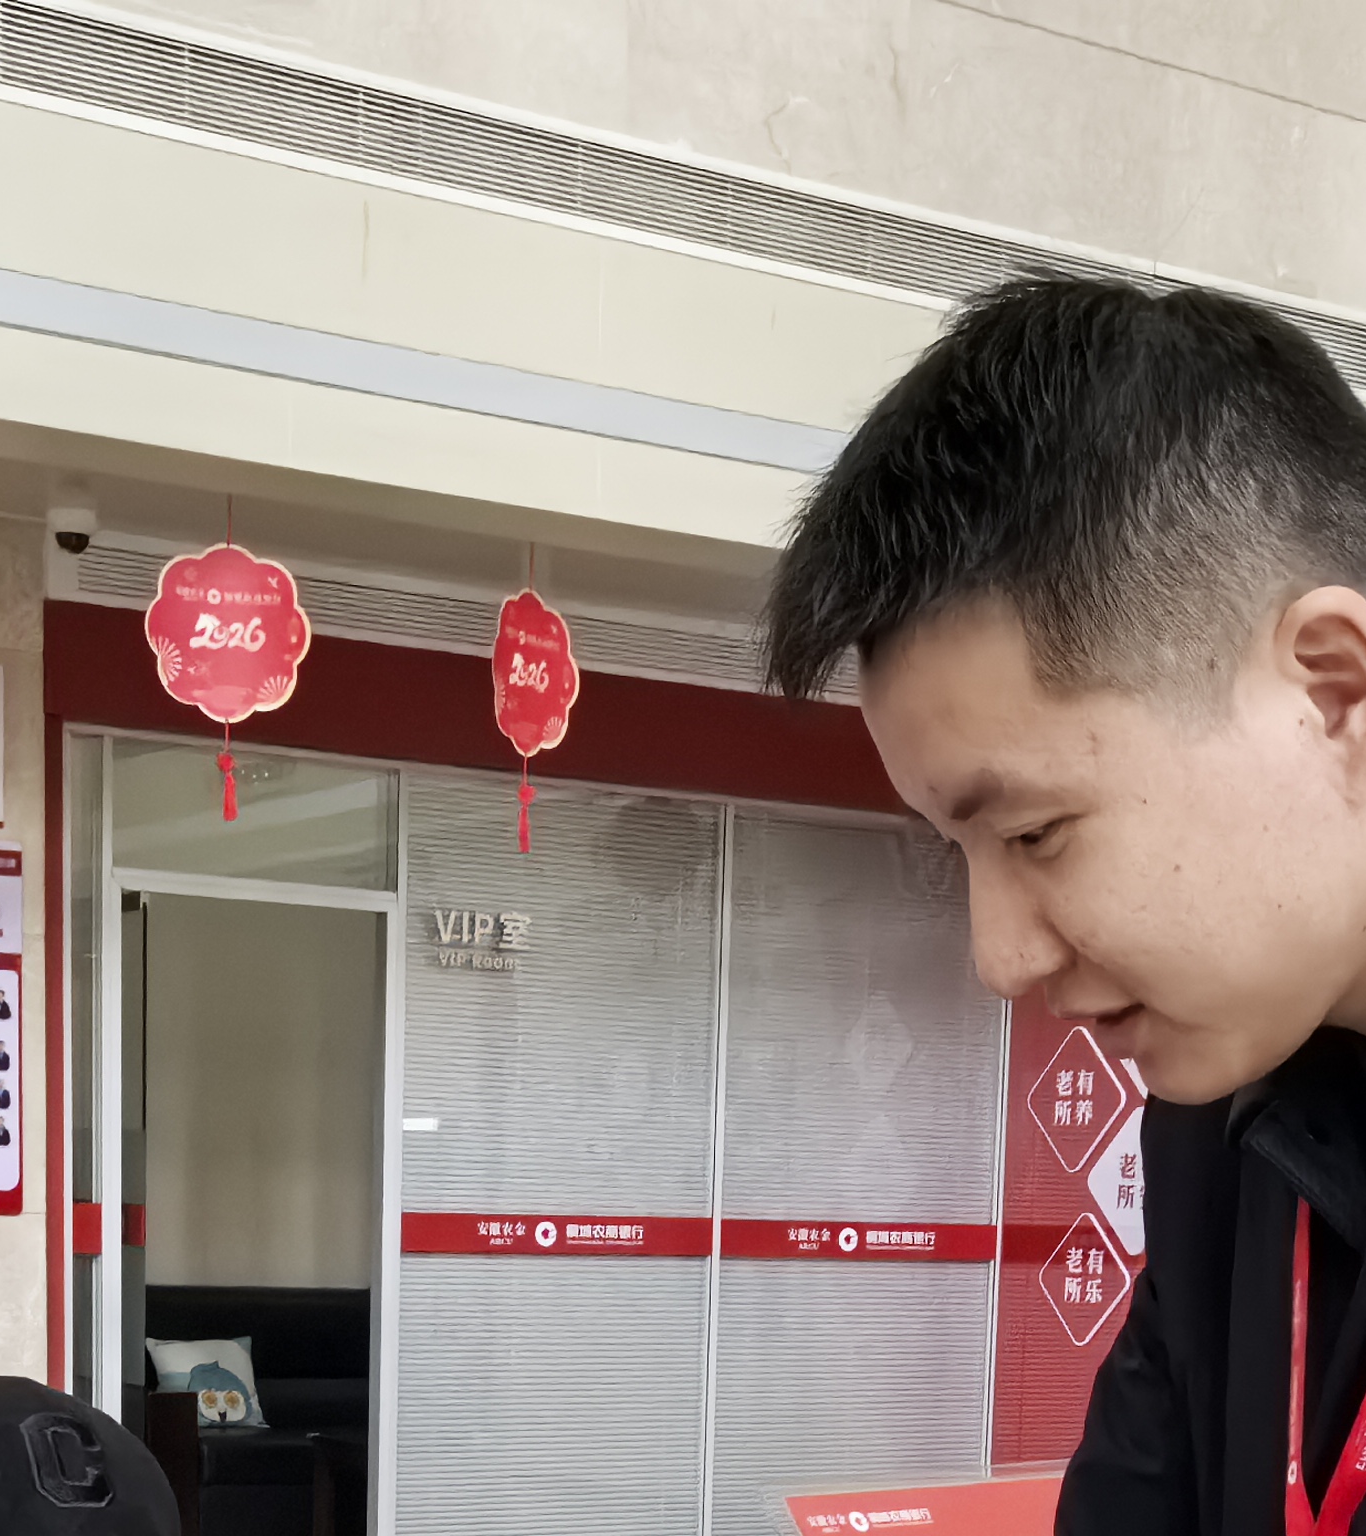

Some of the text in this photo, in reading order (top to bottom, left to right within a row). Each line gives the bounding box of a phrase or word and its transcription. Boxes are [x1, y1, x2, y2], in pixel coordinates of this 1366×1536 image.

[189, 612, 266, 652] 2026
[509, 652, 549, 693] 2026
[434, 909, 533, 950] VIP室
[438, 950, 468, 967] VIP
[1055, 1069, 1095, 1096] 老有
[1054, 1100, 1093, 1126] 所养
[1065, 1246, 1105, 1275] 老有
[1064, 1277, 1104, 1304] 所乐
